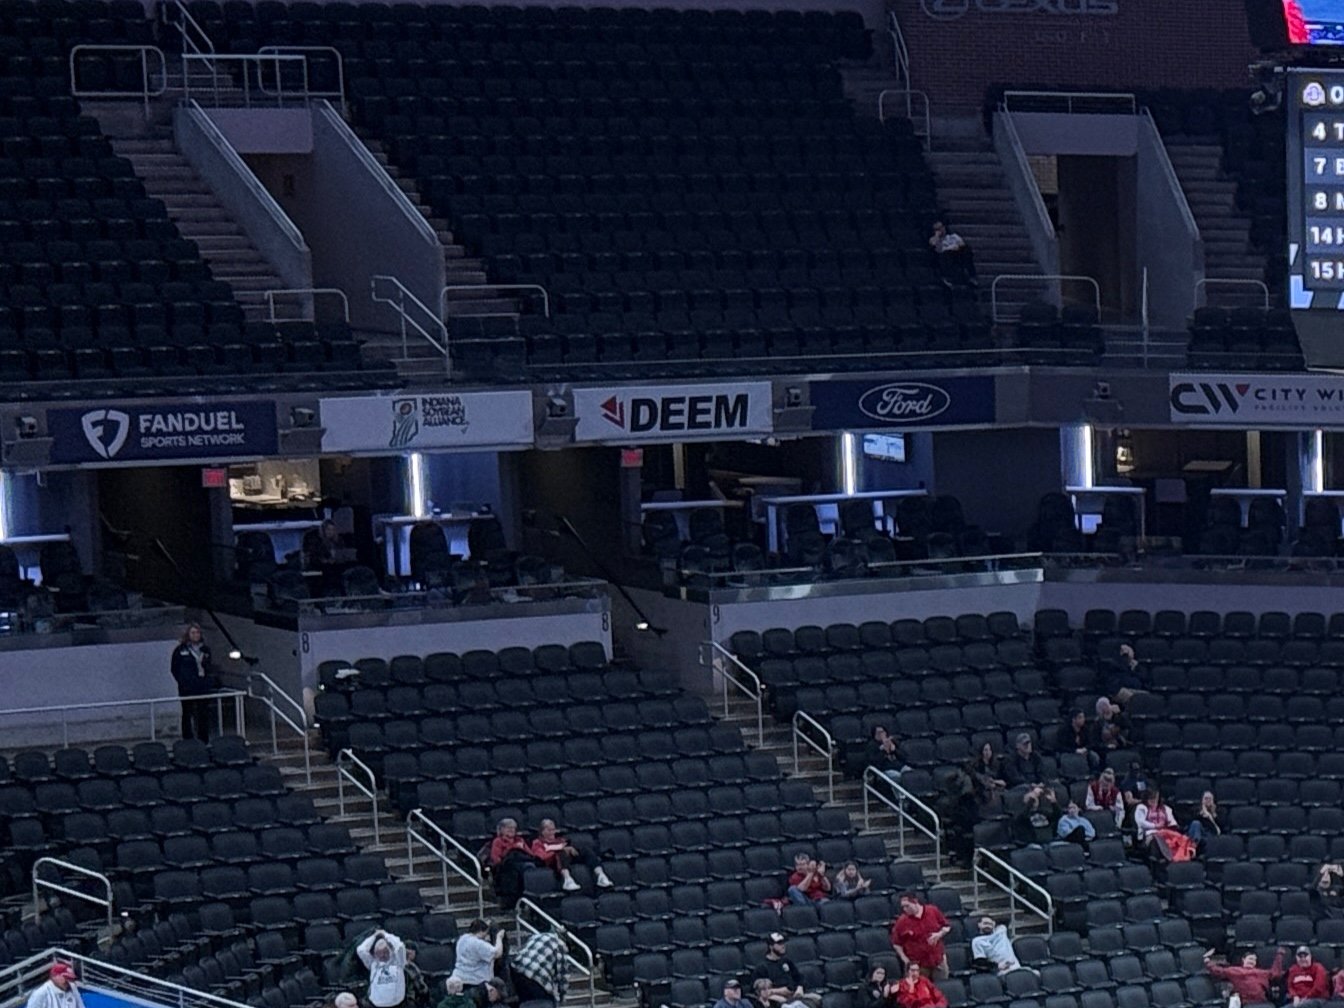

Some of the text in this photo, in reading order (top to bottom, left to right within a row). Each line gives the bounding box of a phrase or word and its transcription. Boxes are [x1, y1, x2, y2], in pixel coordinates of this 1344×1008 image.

[1313, 124, 1326, 141] 4
[1314, 158, 1326, 175] 7
[1314, 192, 1327, 210] 8
[1311, 226, 1333, 244] 14
[1311, 261, 1334, 279] 15
[876, 387, 933, 416] Ford
[1254, 388, 1306, 401] CITY
[630, 394, 748, 433] DEEM
[139, 411, 244, 435] FANDUEL
[141, 432, 245, 449] SPORTS NETWORK
